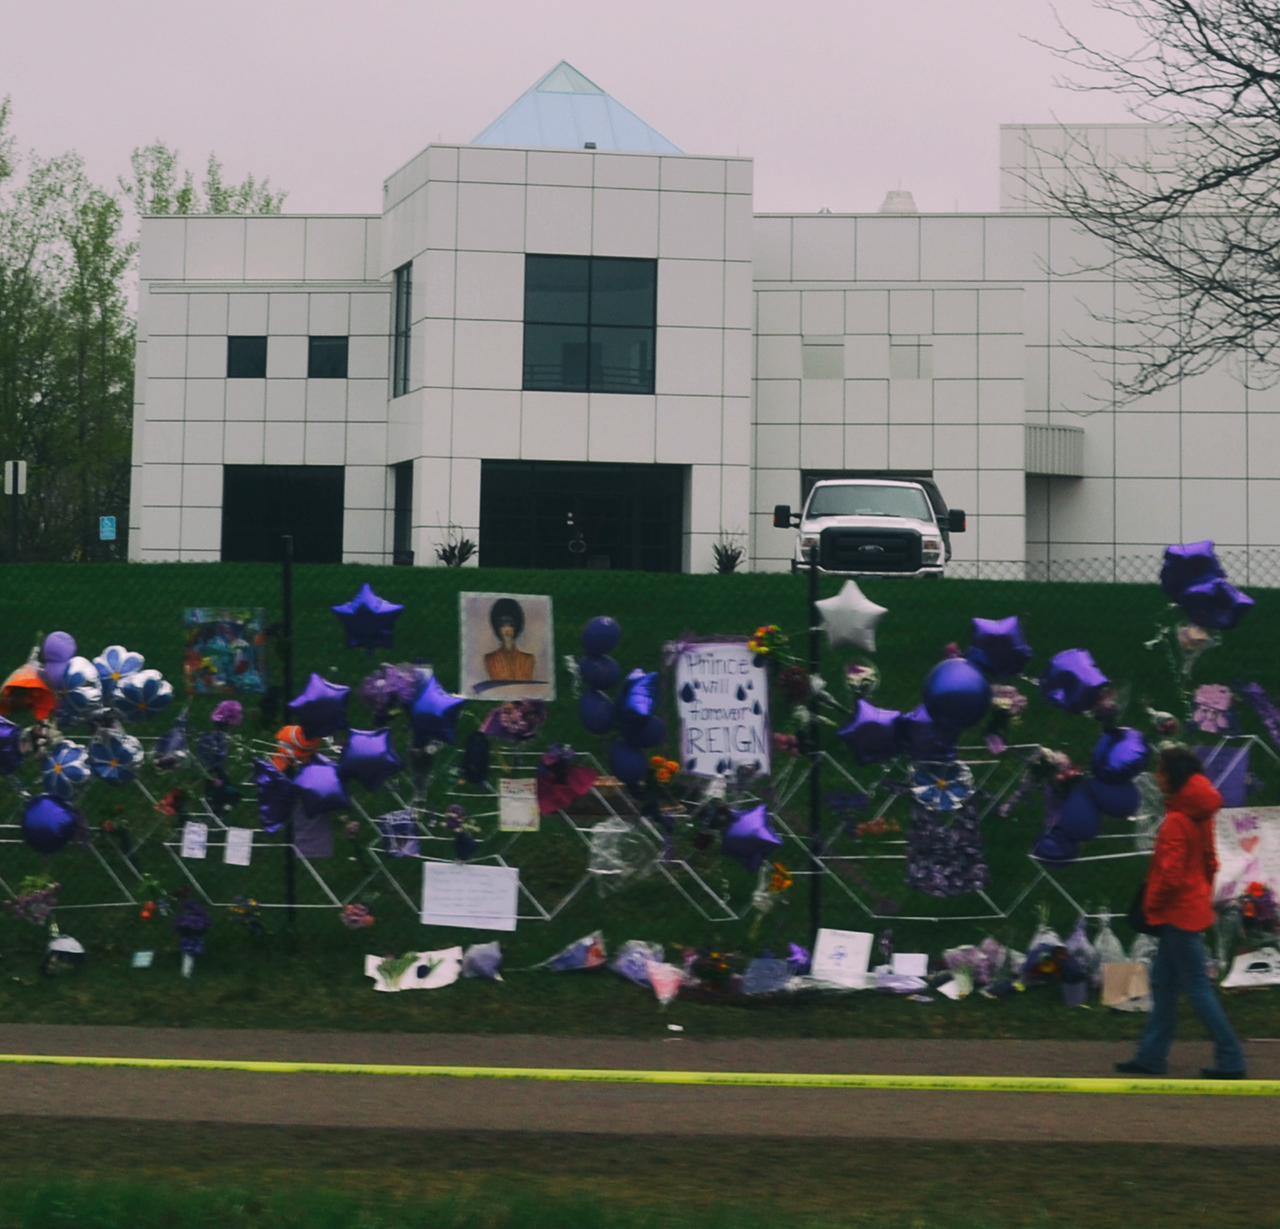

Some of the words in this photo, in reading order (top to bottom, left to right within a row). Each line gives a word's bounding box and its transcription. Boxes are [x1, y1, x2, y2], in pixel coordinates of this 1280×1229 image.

[687, 652, 751, 676] Prince
[702, 679, 730, 695] will
[687, 724, 766, 755] REIGN
